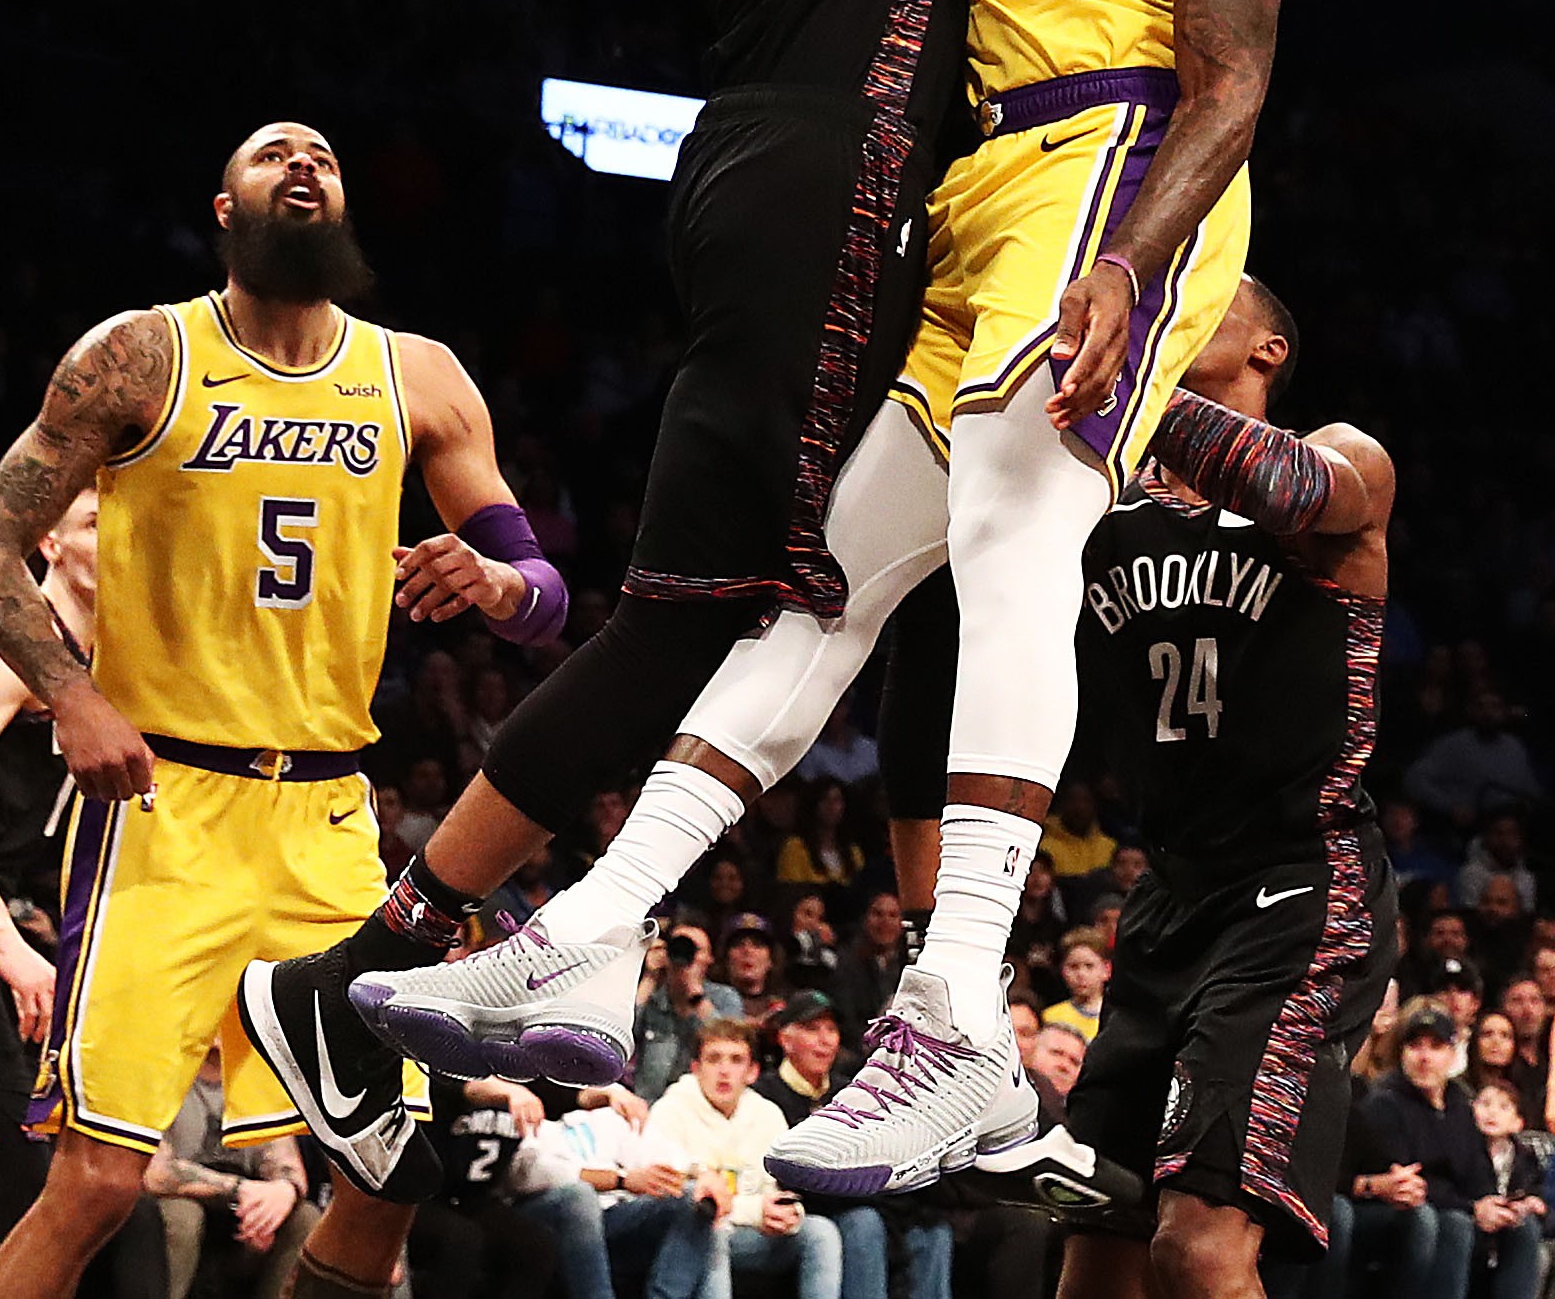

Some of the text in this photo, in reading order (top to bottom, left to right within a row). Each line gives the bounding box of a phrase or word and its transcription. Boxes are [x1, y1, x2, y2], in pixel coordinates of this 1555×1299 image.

[333, 383, 382, 399] wish
[179, 402, 384, 479] LAKERS
[255, 496, 319, 610] 5
[1086, 550, 1284, 635] BROOKLYN
[1148, 637, 1223, 743] 24
